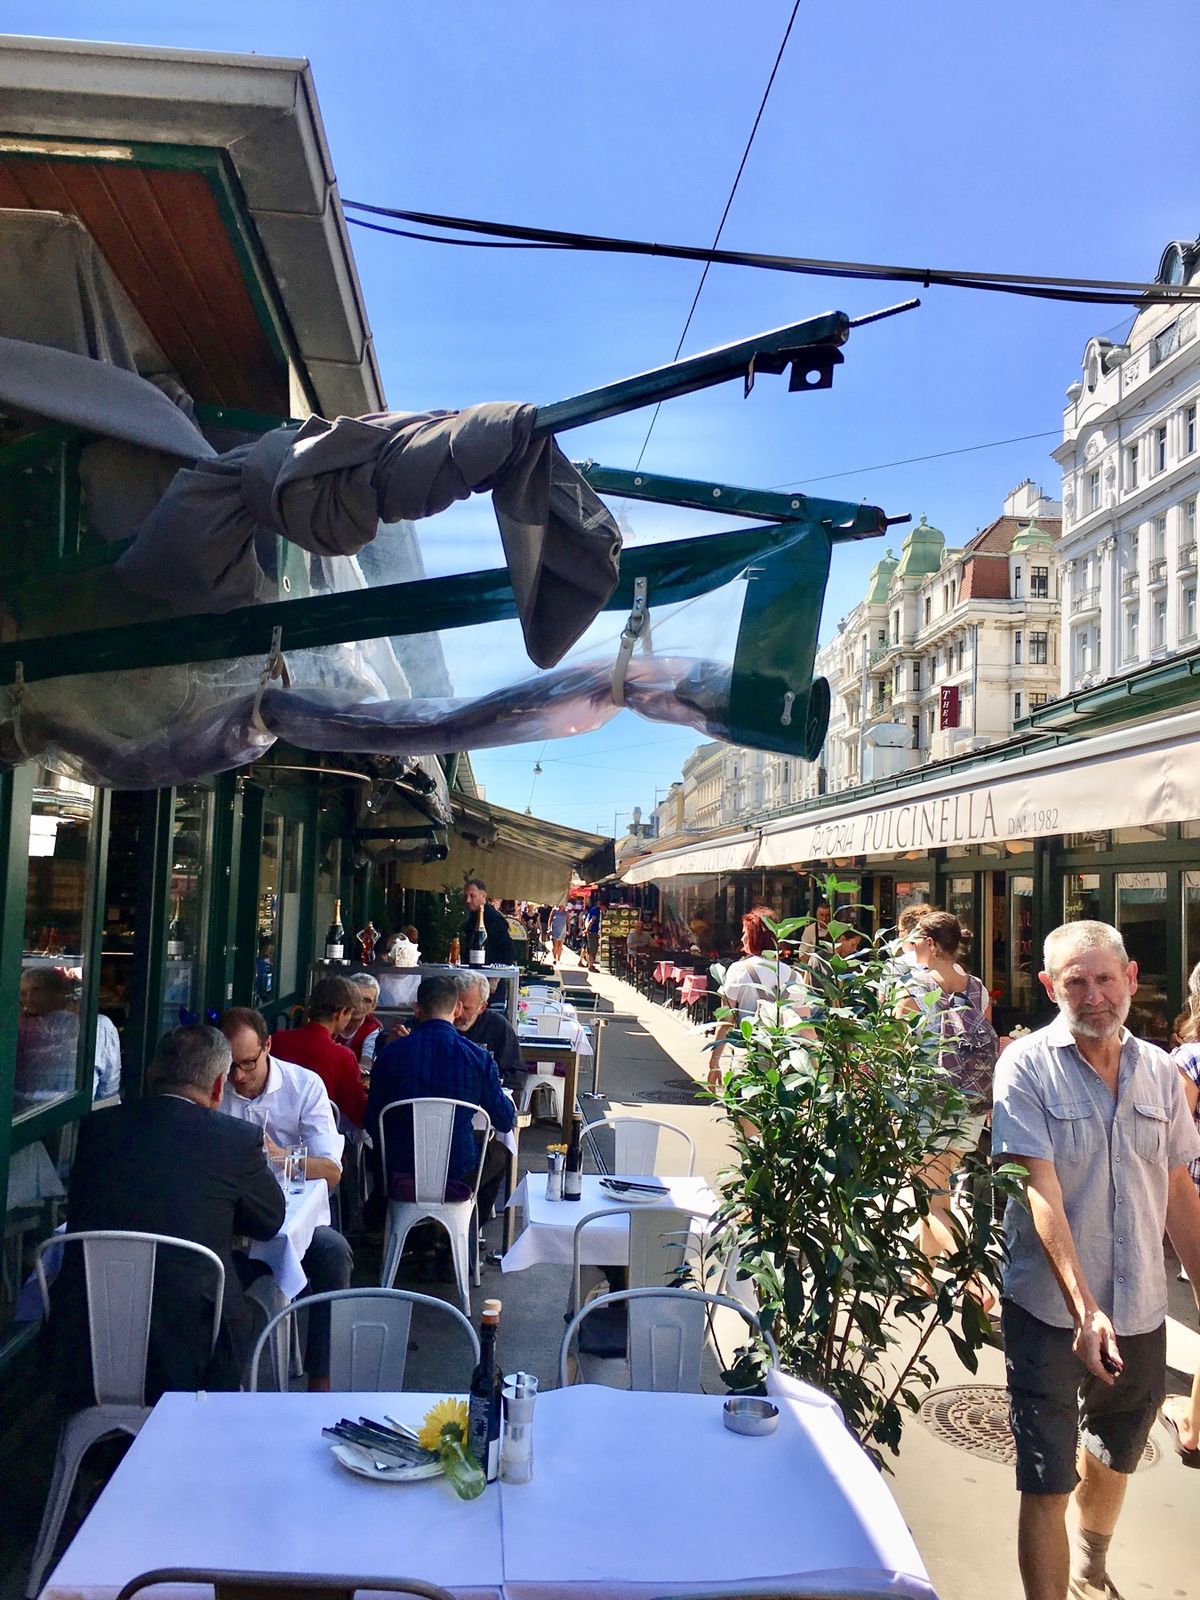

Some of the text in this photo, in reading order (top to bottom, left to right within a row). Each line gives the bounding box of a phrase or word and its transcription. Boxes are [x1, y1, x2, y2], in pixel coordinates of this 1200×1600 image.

[862, 789, 998, 851] PULCINELLA
[1008, 815, 1028, 834] DAL
[1033, 807, 1059, 831] 1982
